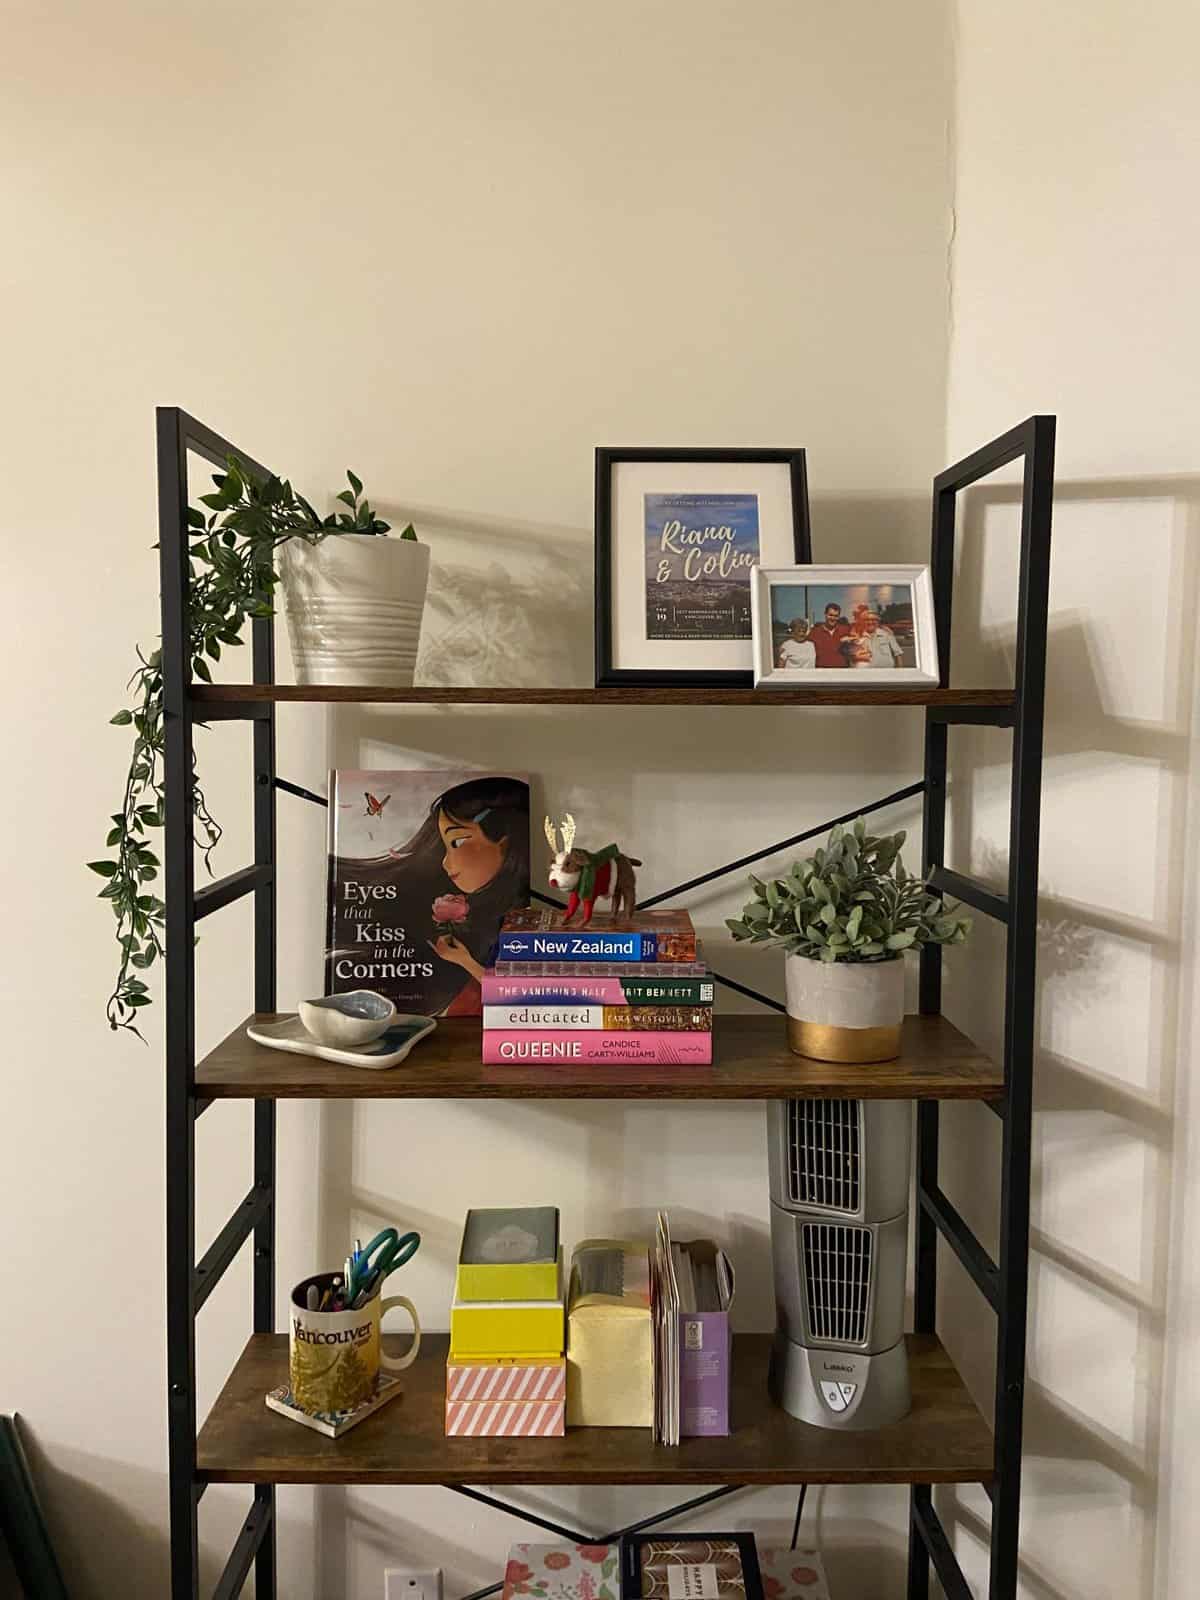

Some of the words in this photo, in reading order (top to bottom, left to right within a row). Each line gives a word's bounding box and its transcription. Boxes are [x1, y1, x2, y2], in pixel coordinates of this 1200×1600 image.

[661, 520, 737, 554] Riana
[656, 560, 672, 583] &
[684, 541, 754, 581] Colin
[343, 881, 397, 904] Eyes
[344, 906, 372, 919] that
[356, 923, 405, 942] Kiss
[374, 945, 387, 959] in
[392, 945, 414, 958] the
[533, 939, 568, 953] New
[572, 939, 633, 954] Zealand
[335, 960, 433, 979] Corners
[498, 986, 519, 996] THE
[509, 1009, 590, 1024] educated
[500, 1042, 582, 1059] QUEENIE
[602, 1040, 641, 1048] CANDICE
[587, 1050, 655, 1058] CARTY-WILLIAMS
[293, 1317, 372, 1344] Vancouver
